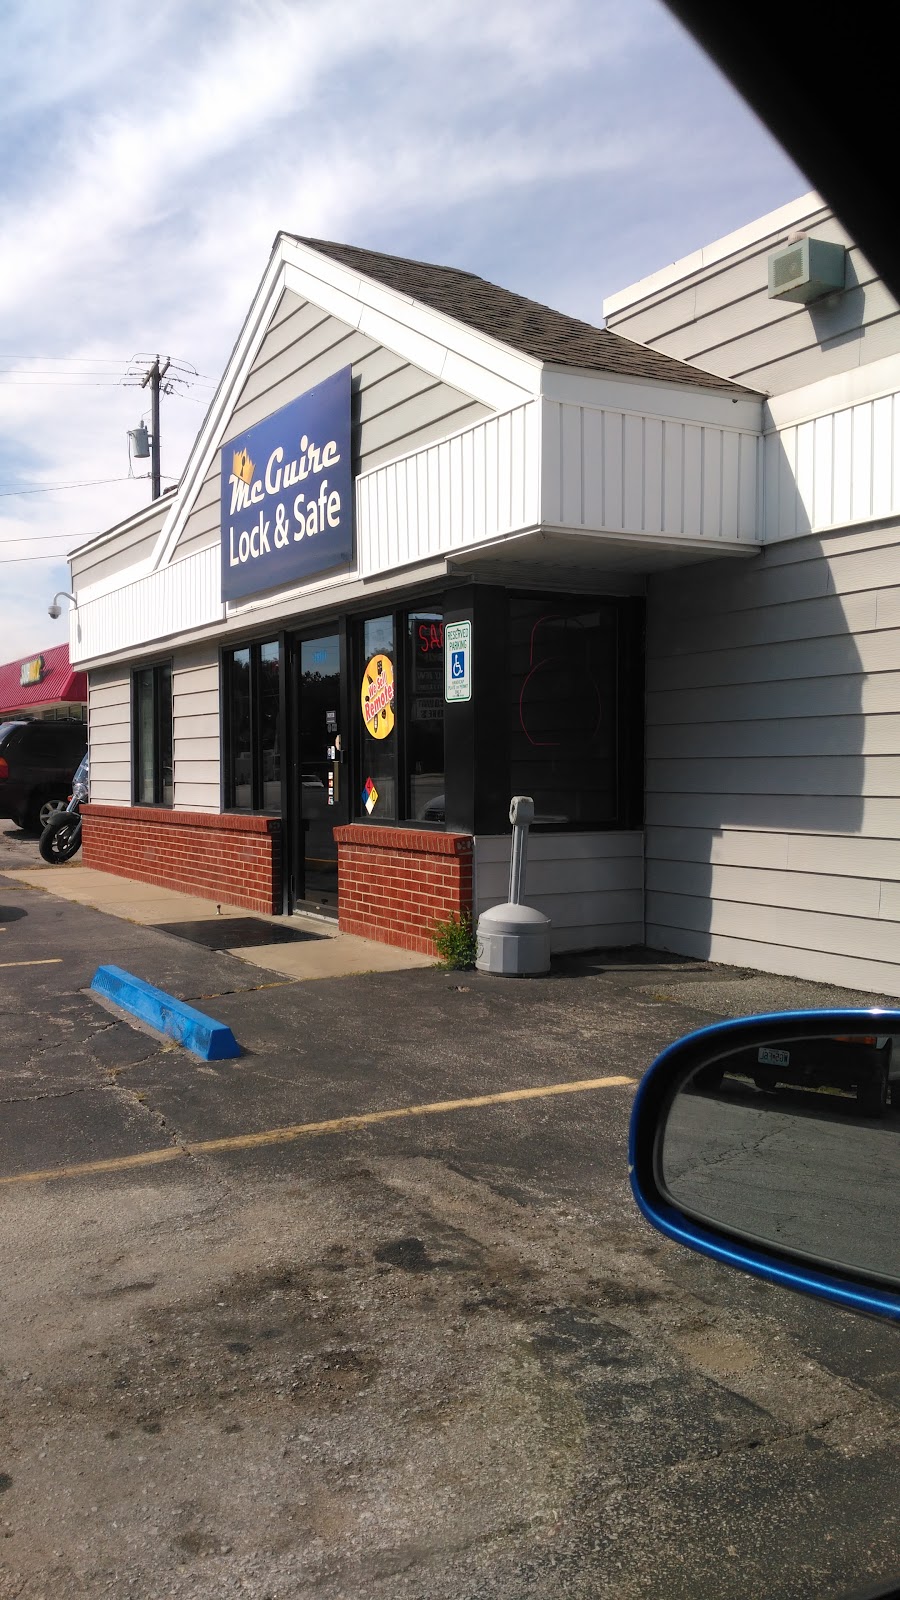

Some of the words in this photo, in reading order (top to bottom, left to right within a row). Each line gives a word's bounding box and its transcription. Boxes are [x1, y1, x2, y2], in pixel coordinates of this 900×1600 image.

[229, 435, 341, 516] McGuire
[229, 510, 271, 567] Lock
[274, 503, 290, 549] &
[293, 479, 341, 542] Safe
[448, 628, 469, 640] RESERVED
[449, 639, 467, 651] PARKING
[368, 683, 377, 698] We
[376, 671, 387, 690] Sell
